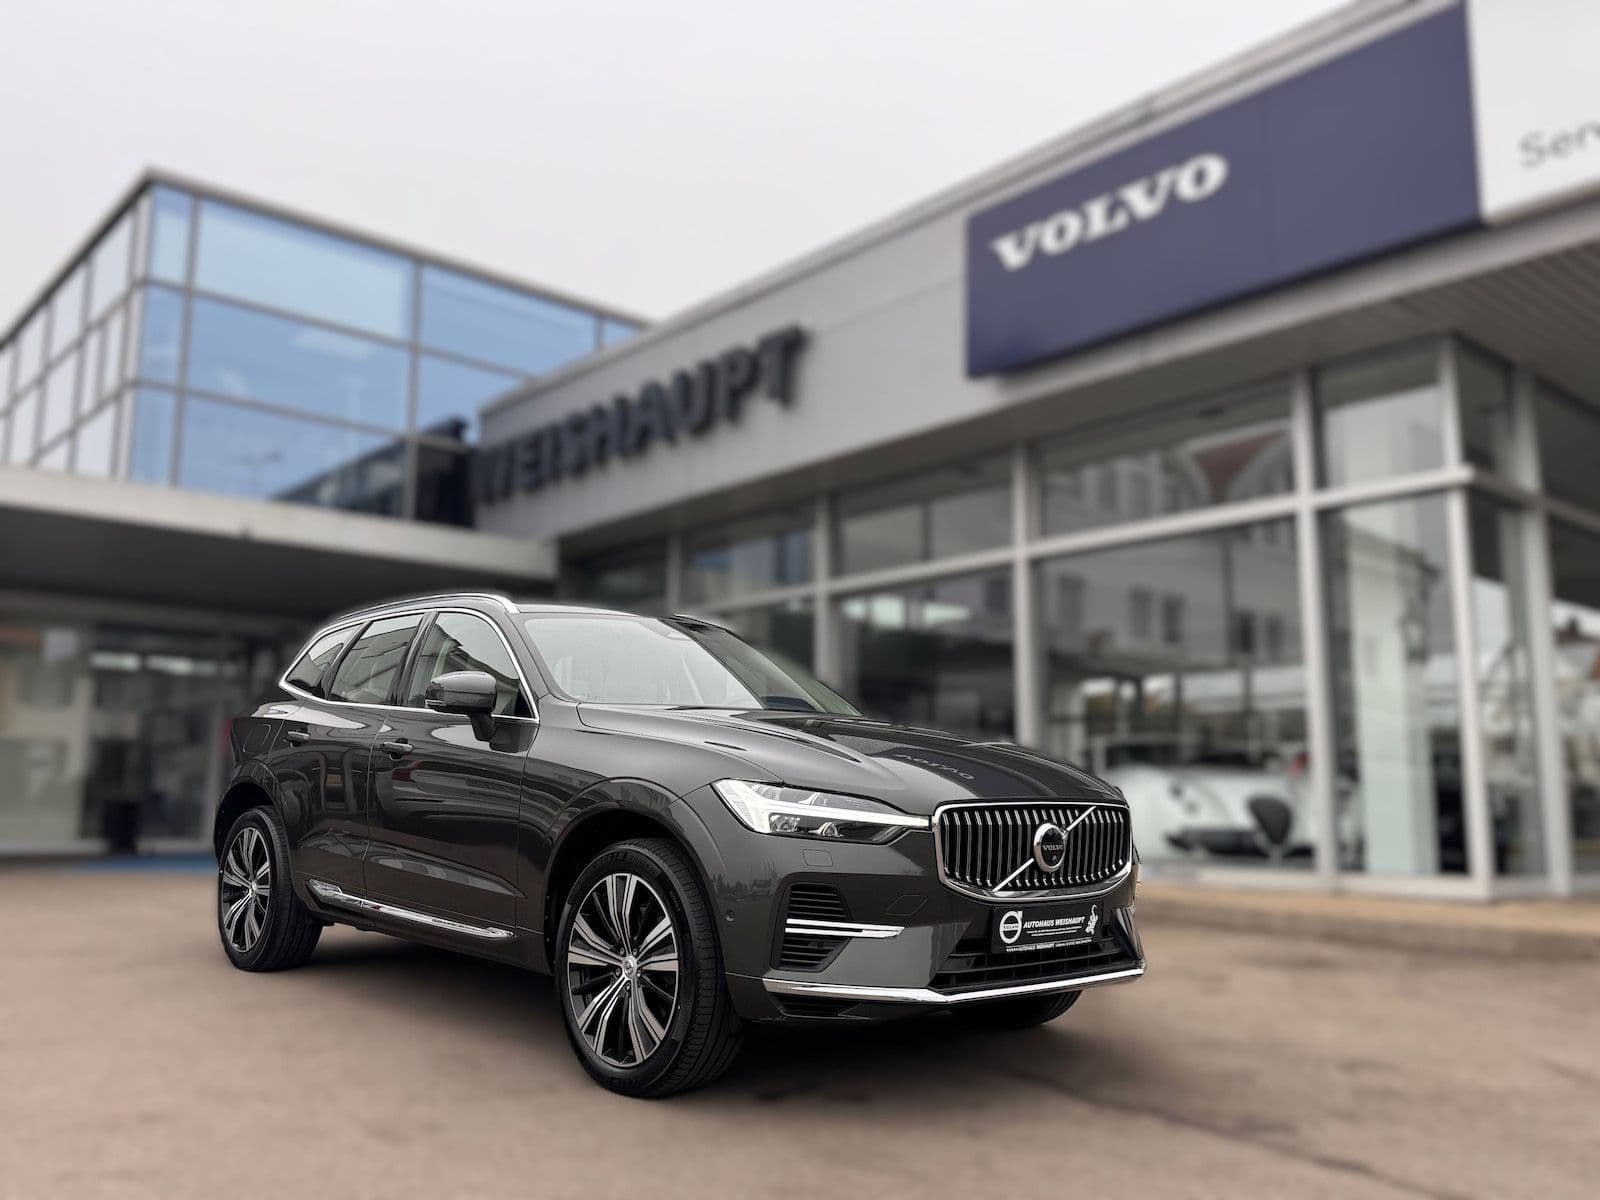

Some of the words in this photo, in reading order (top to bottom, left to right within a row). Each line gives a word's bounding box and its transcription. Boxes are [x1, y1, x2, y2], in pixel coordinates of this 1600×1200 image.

[991, 152, 1228, 272] VOLVO
[473, 323, 810, 505] WEISHAUPT
[1023, 919, 1054, 929] AUTOHAUS
[1055, 916, 1085, 926] WEISHAUPT
